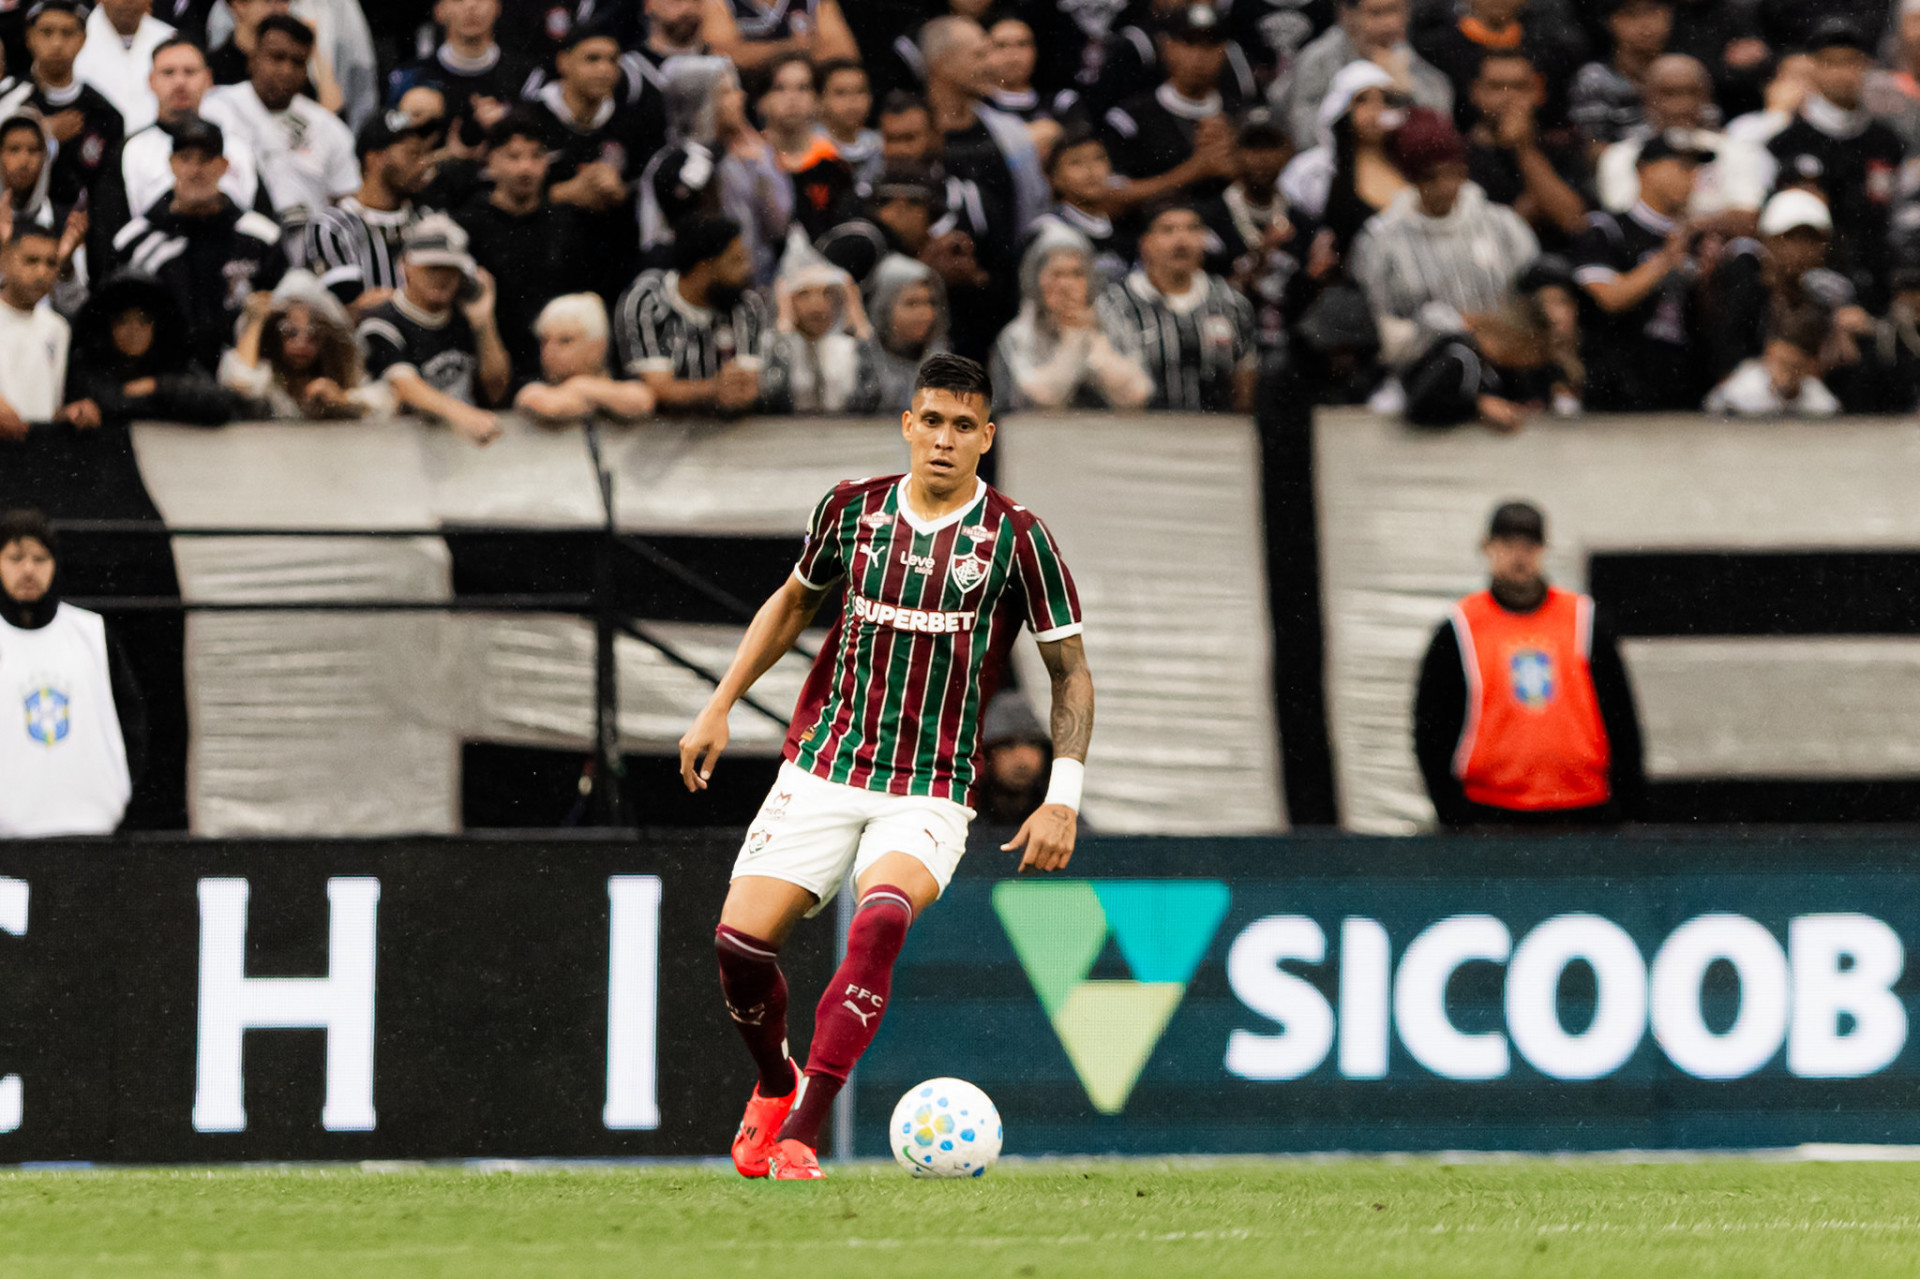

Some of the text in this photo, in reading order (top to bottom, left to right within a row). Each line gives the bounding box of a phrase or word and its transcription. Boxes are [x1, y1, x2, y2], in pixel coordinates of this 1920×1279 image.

[900, 551, 936, 569] Leve
[855, 595, 975, 633] SUPERBET
[845, 983, 884, 1008] FFC
[1225, 912, 1906, 1081] SICOOB
